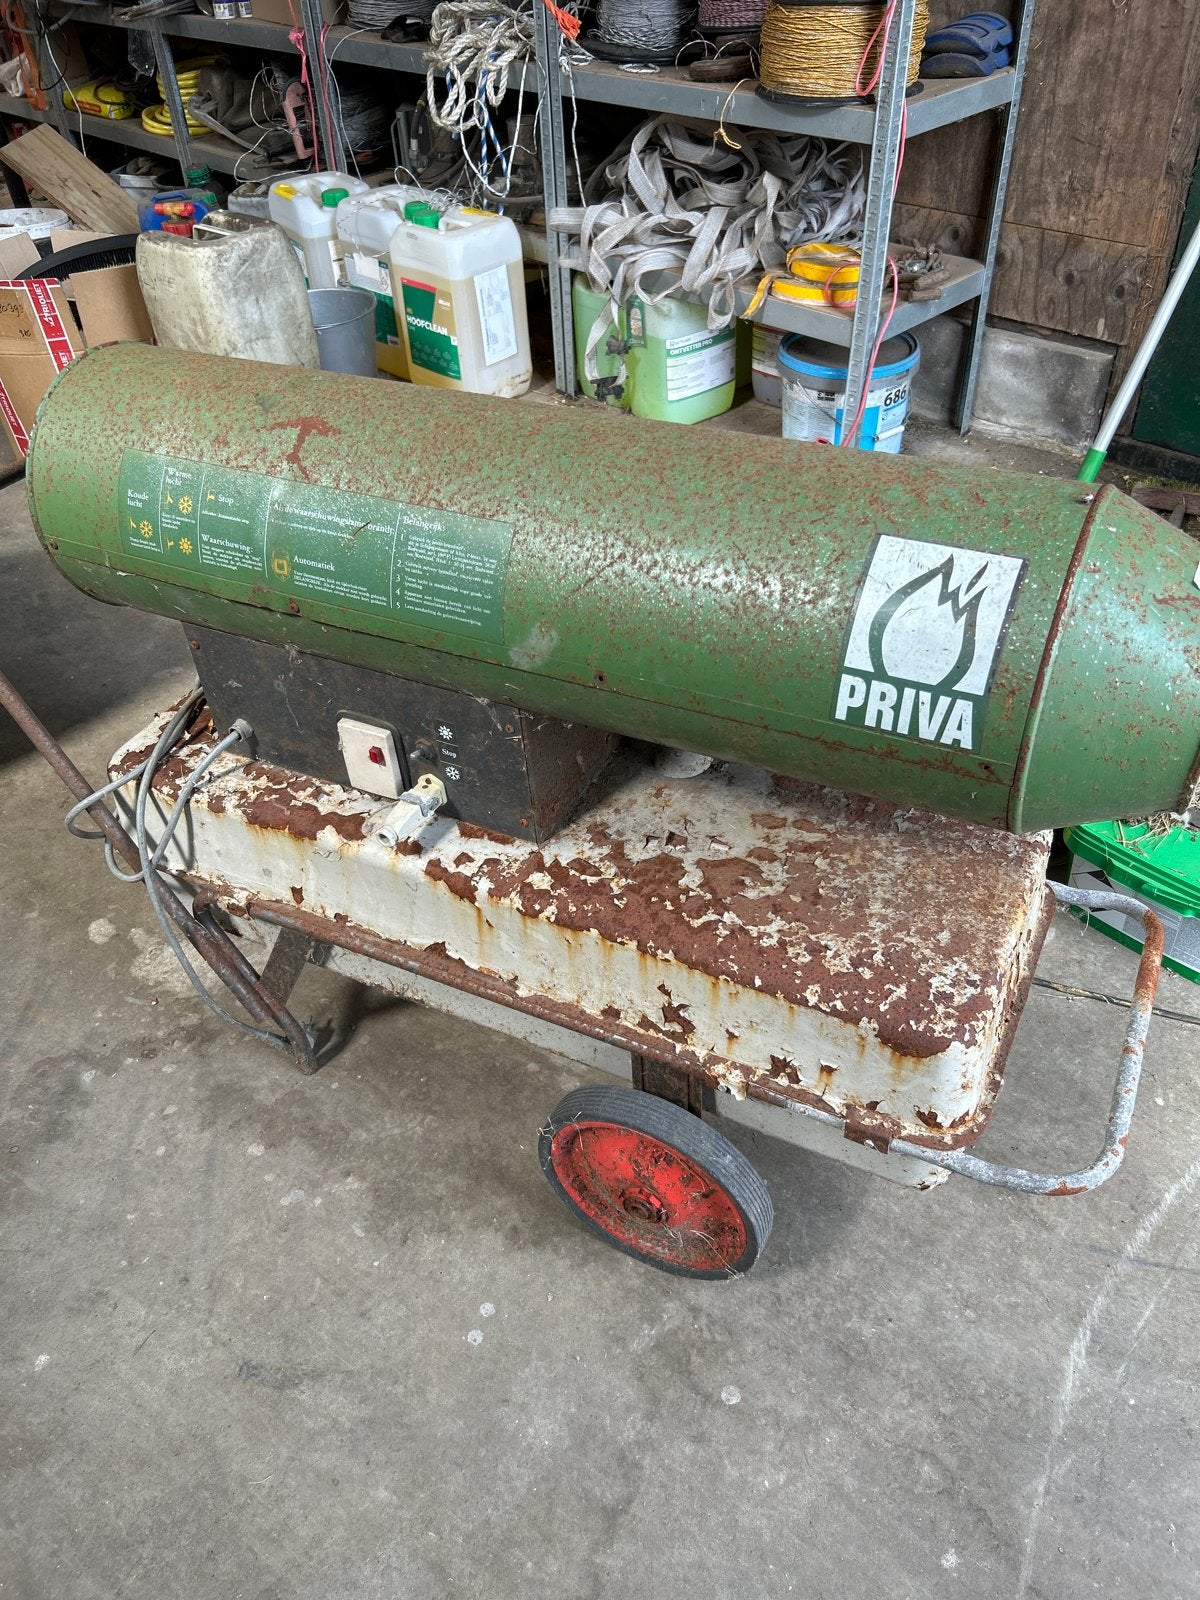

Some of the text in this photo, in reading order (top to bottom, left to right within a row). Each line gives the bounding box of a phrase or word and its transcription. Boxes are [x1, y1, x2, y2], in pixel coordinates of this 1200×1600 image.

[407, 314, 448, 336] HOOFCLEAN
[884, 384, 907, 407] 686
[128, 489, 149, 501] Koude
[128, 498, 143, 508] lucht
[218, 494, 234, 506] Stop
[201, 533, 253, 554] Waarschuwing:
[293, 555, 336, 571] Automatiek
[834, 673, 973, 750] PRIVA
